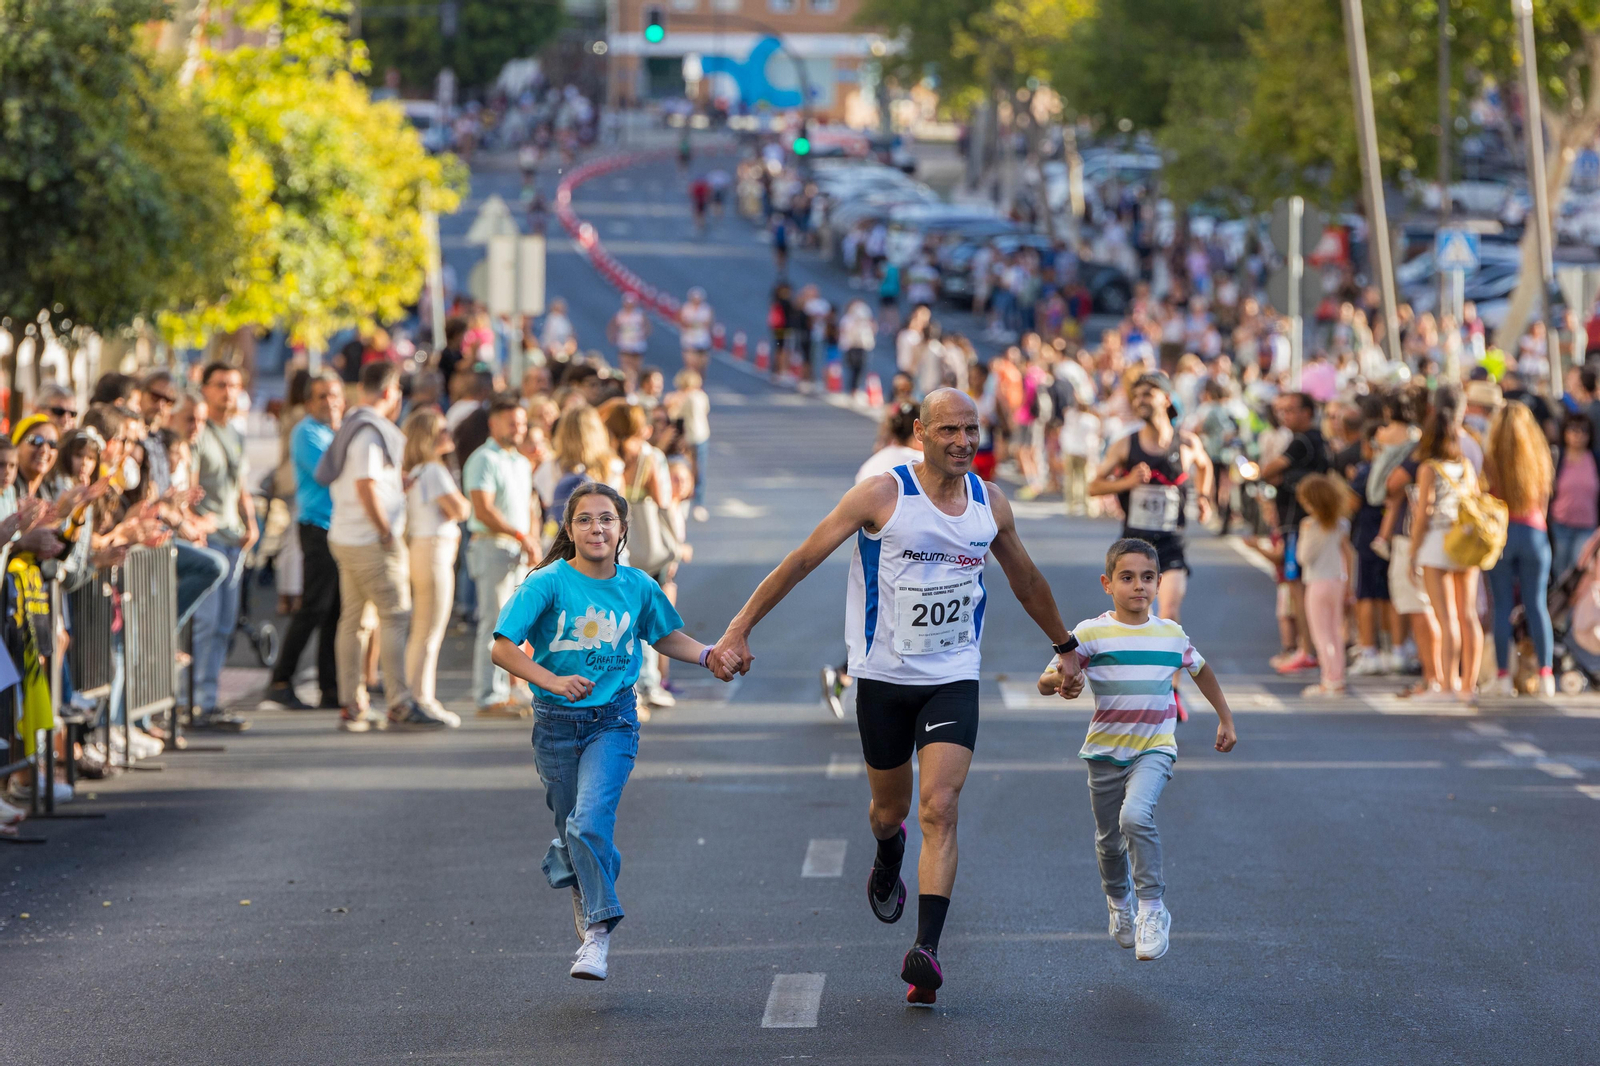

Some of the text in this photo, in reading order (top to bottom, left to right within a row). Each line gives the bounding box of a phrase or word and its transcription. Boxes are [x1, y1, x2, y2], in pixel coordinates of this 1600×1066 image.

[902, 550, 983, 566] ReturntoSpor
[912, 599, 960, 626] 202
[585, 650, 615, 666] GREAT
